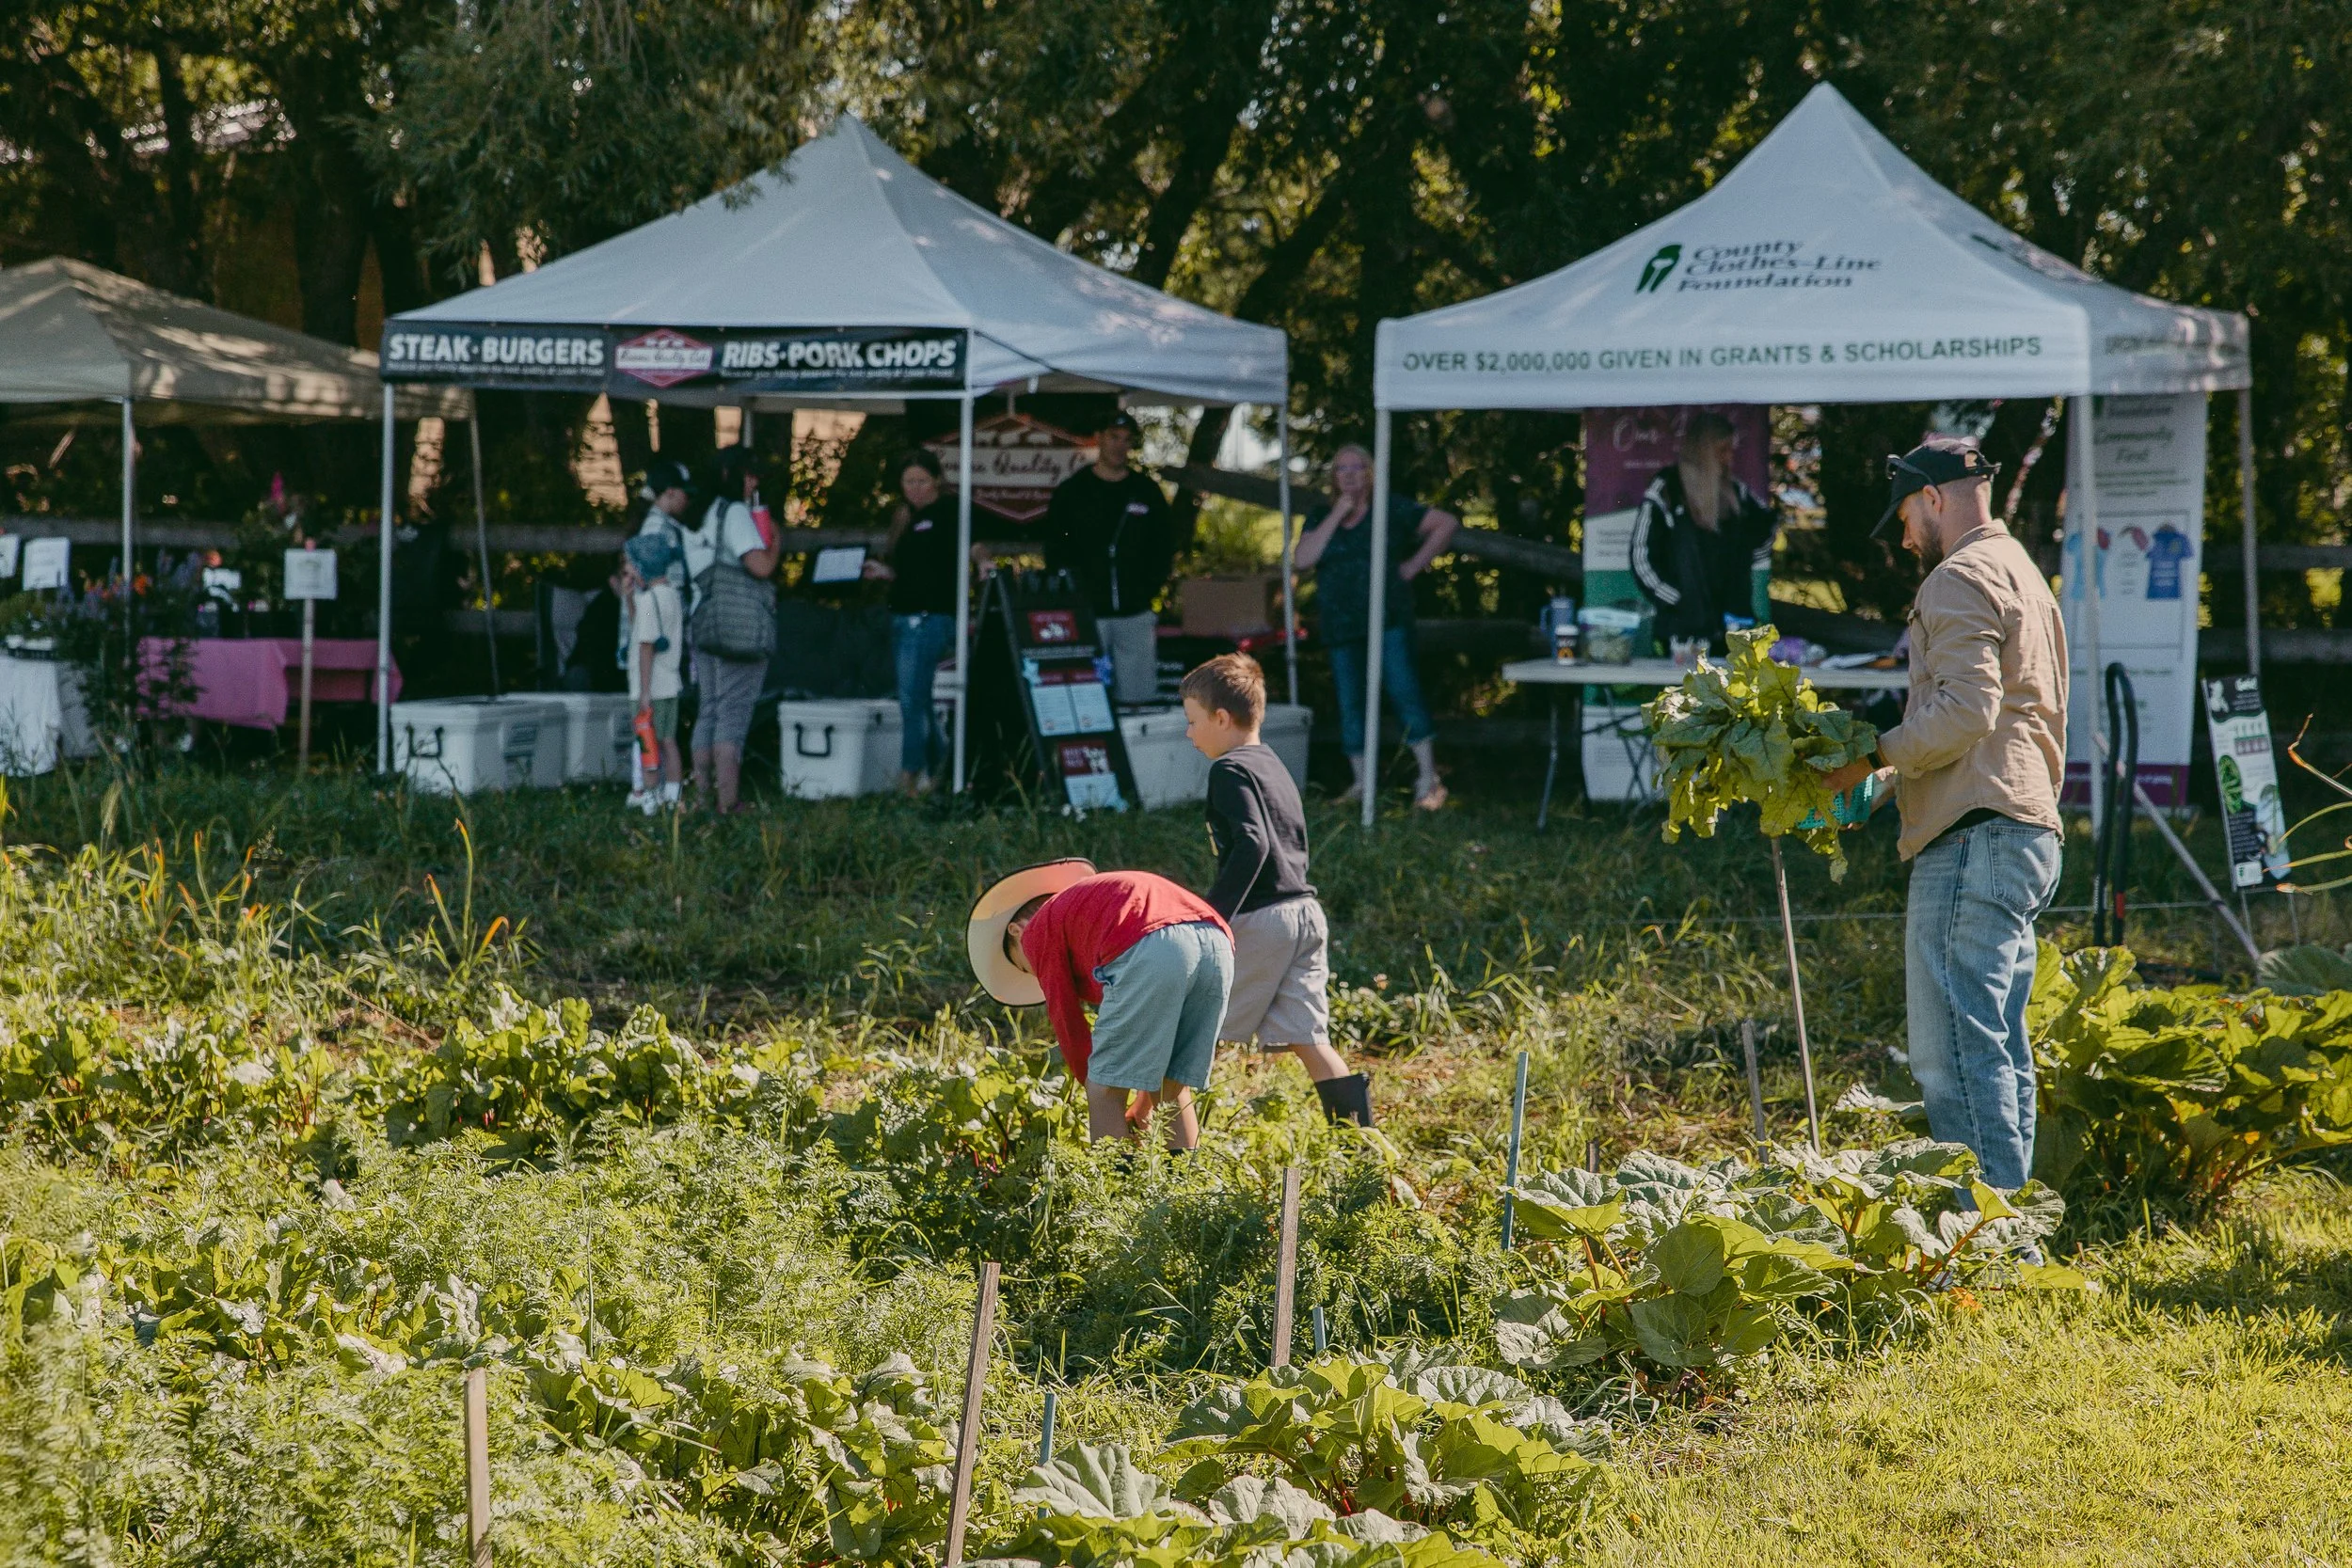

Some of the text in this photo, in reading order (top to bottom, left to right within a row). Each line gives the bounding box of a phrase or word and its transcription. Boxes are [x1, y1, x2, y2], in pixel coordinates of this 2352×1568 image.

[1694, 241, 1803, 261] County
[1678, 272, 1851, 293] Foundation
[865, 339, 957, 367] CHOPS
[1403, 336, 2042, 375] OVER $2,000,000 GIVEN IN GRANTS & SCHOLARSHIPS
